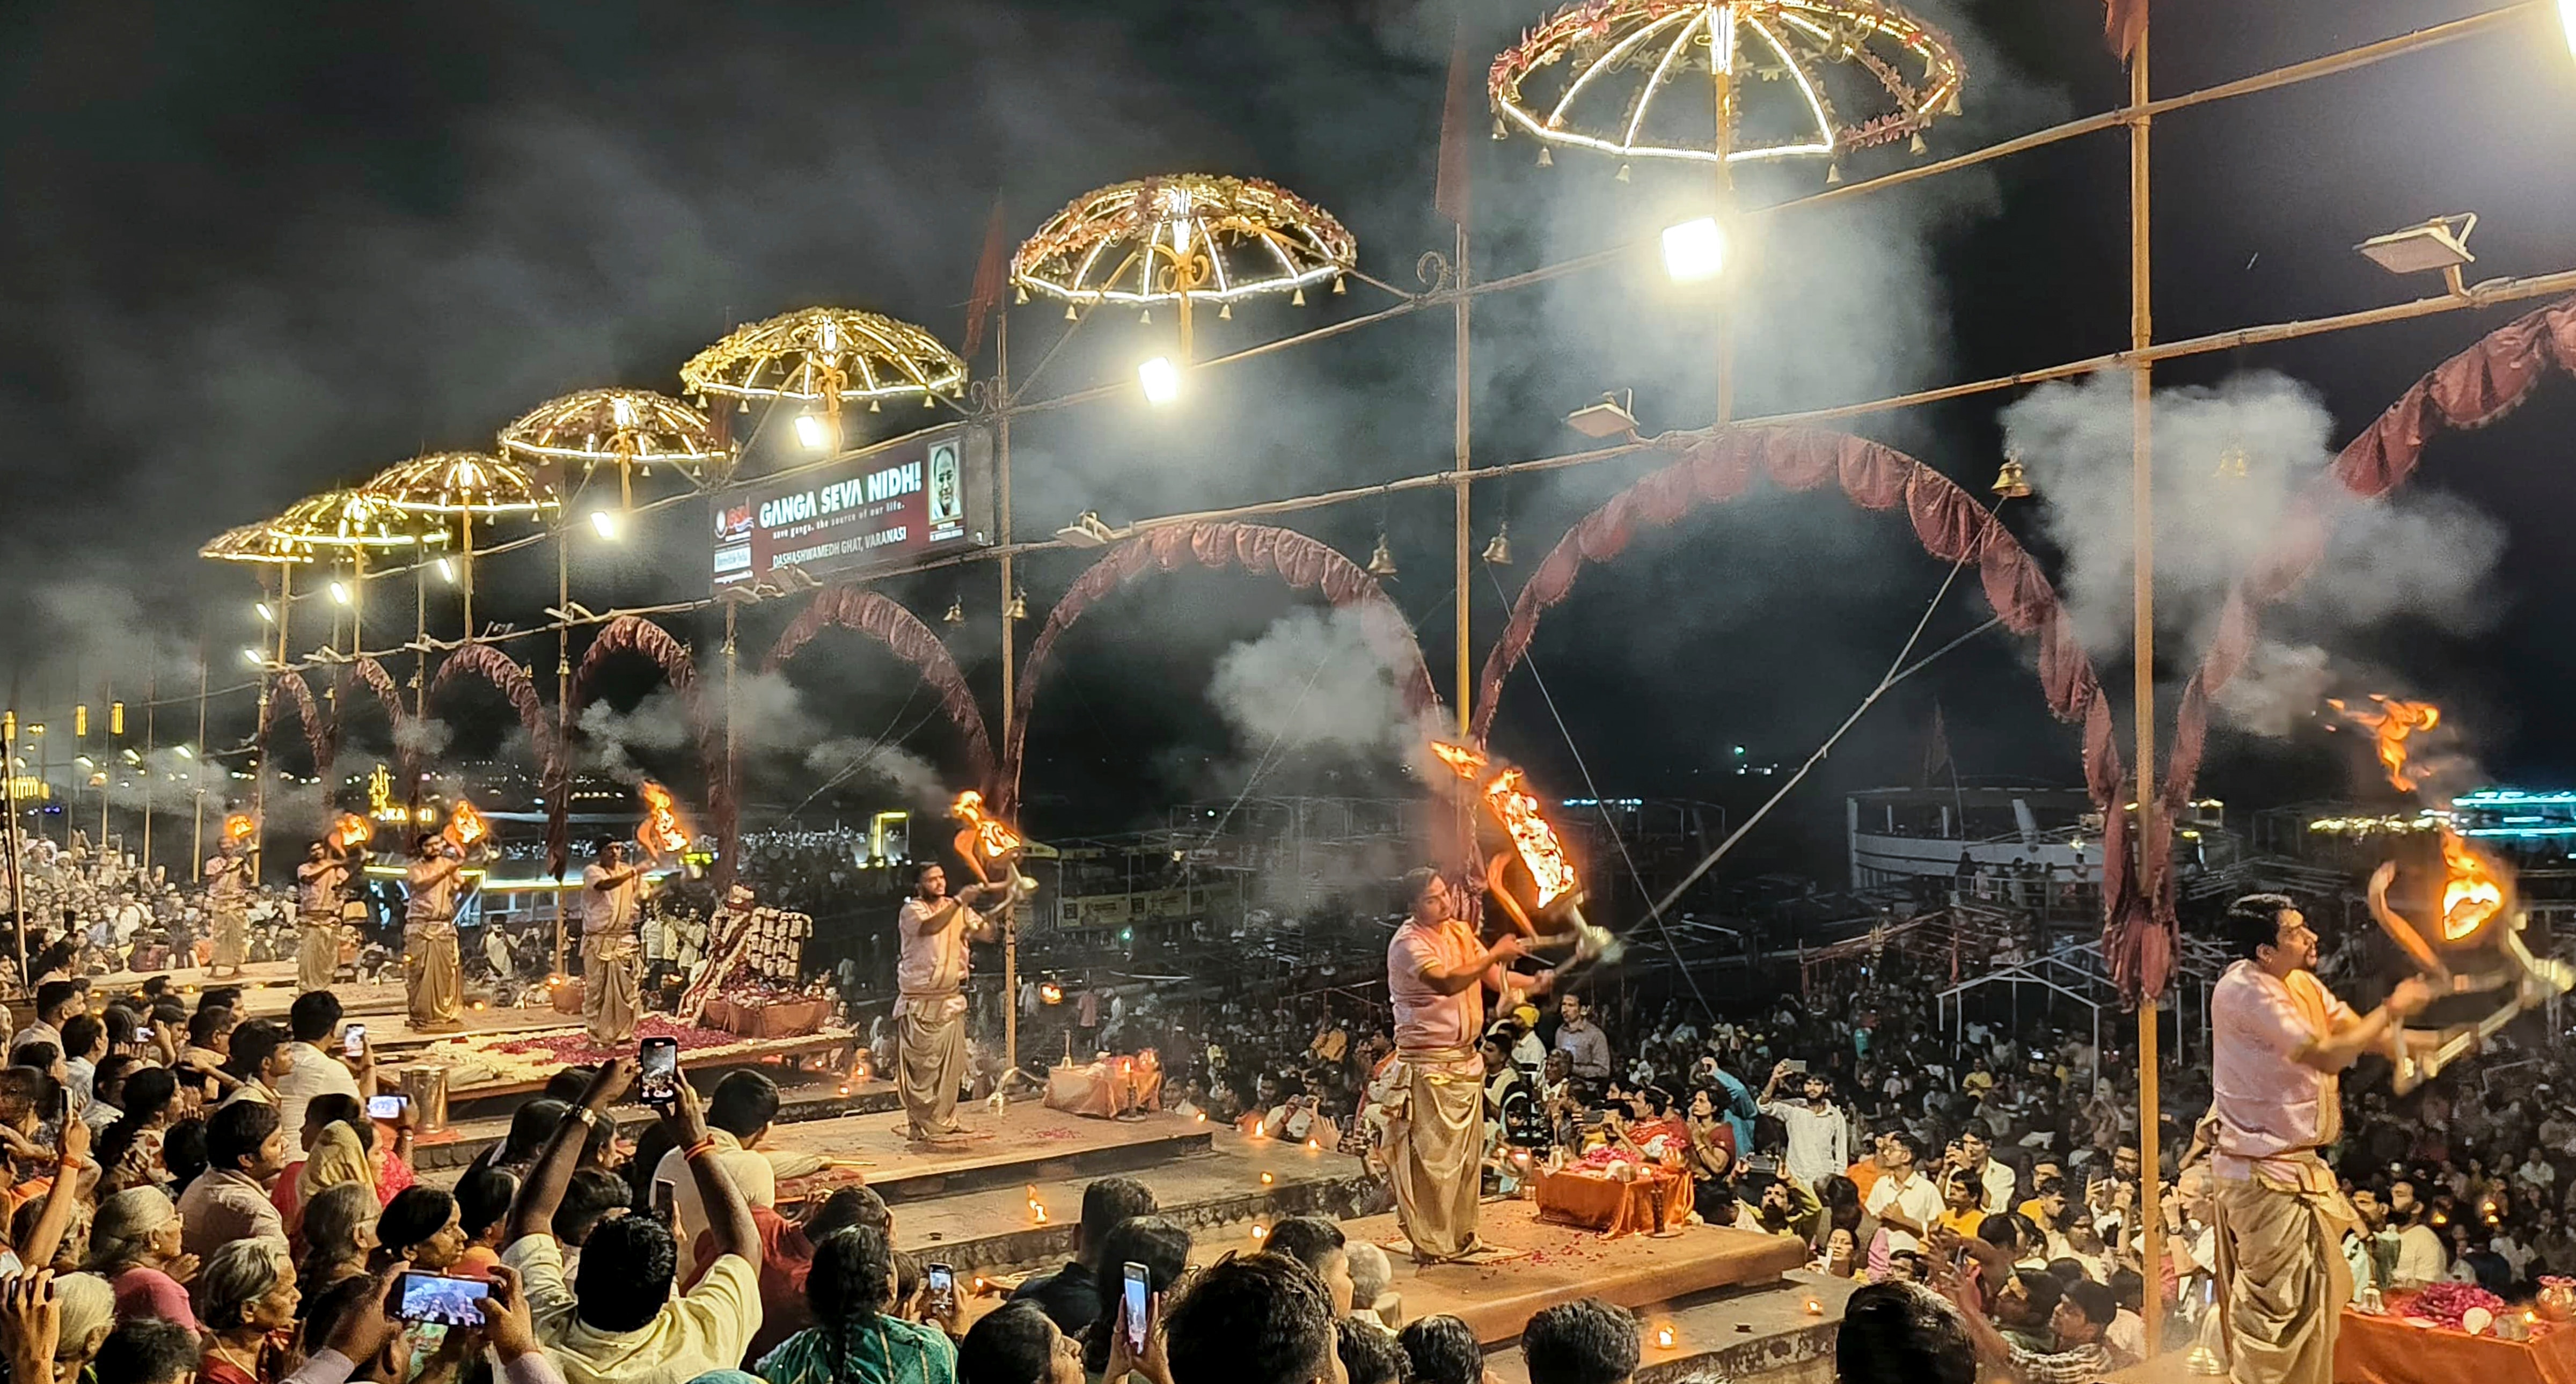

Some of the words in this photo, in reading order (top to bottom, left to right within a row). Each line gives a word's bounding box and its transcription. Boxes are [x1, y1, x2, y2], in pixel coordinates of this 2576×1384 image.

[760, 490, 817, 529] GANGA
[821, 478, 863, 514] SEVA
[773, 529, 788, 539] save
[817, 519, 829, 529] the
[832, 514, 856, 526] source
[859, 508, 867, 519] of
[870, 507, 884, 517] our
[887, 500, 905, 512] life.
[773, 541, 840, 569] DASHASHWAMEDH
[841, 536, 863, 554] GHAT,
[865, 526, 906, 549] VARANASI
